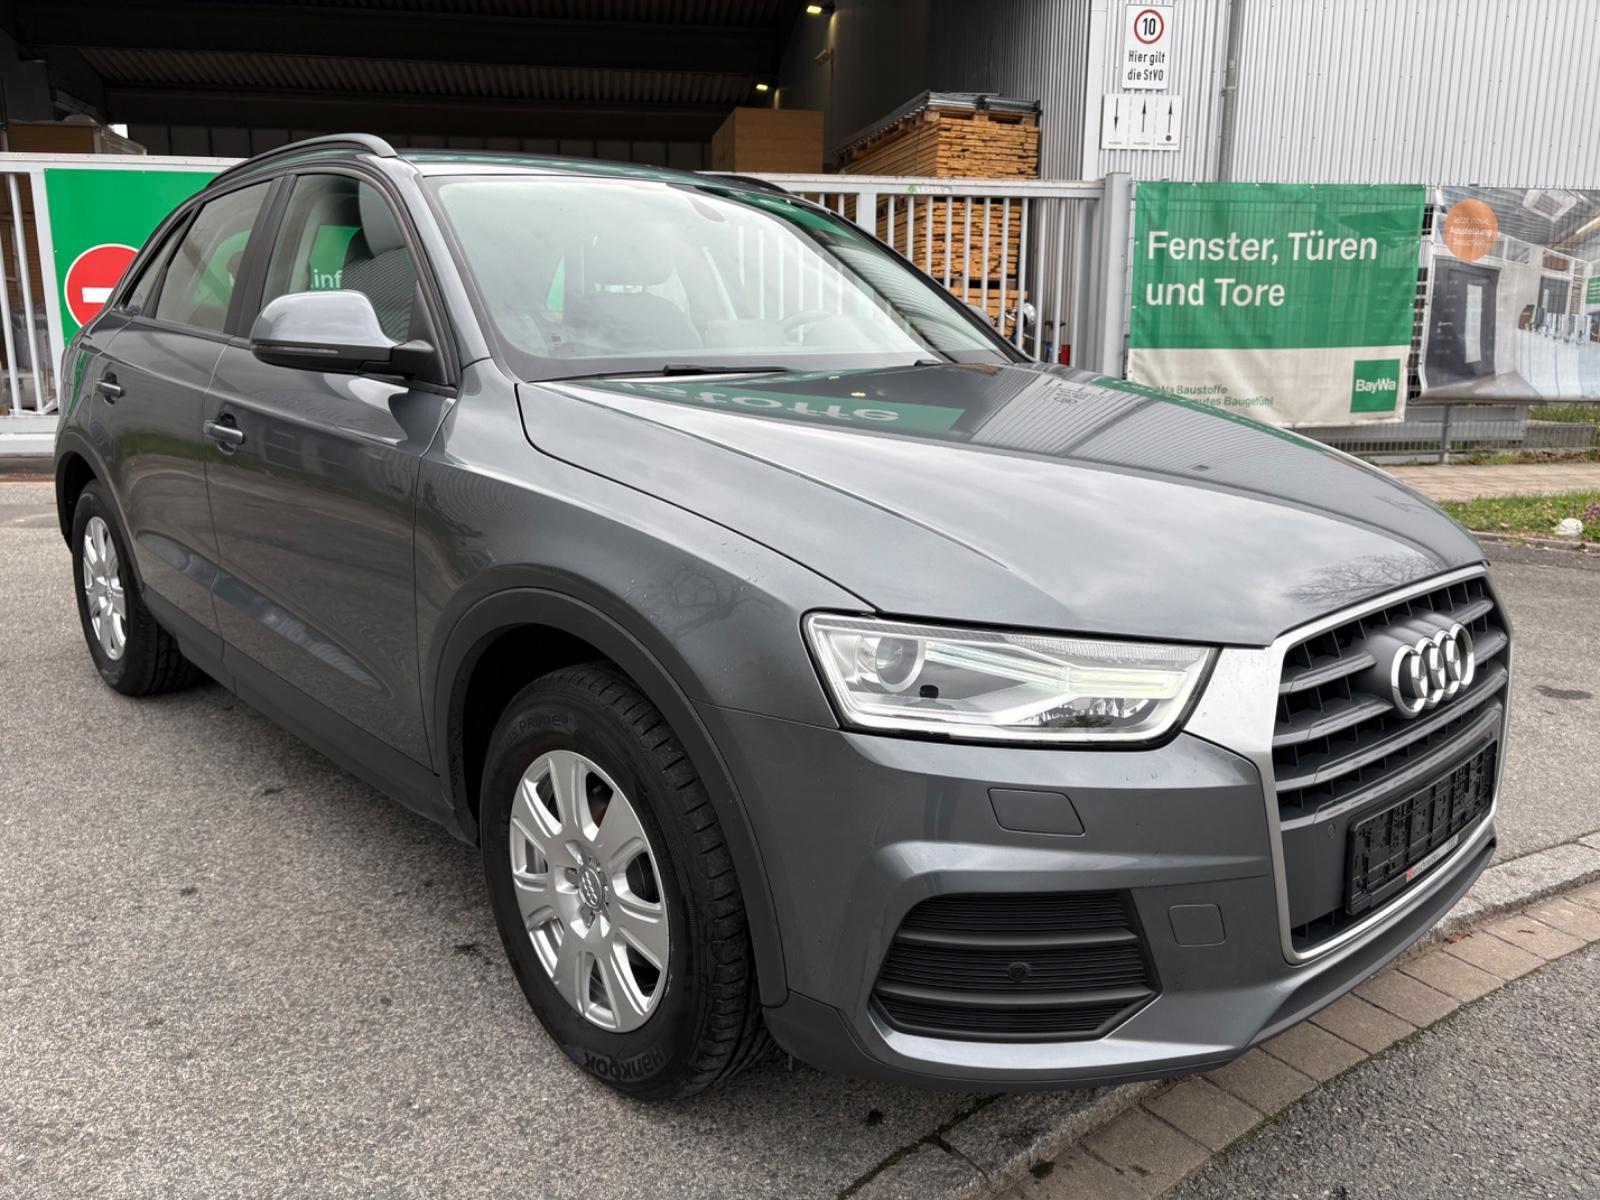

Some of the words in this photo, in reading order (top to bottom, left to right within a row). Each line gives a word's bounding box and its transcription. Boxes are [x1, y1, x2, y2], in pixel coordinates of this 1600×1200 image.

[1142, 17, 1156, 36] 10
[1128, 49, 1147, 63] Hier
[1149, 51, 1165, 66] gilt
[1127, 68, 1142, 81] die
[1143, 69, 1164, 82] StVO
[1148, 230, 1278, 265] Fenster,
[1288, 229, 1378, 261] Türen
[1145, 277, 1205, 306] und
[1214, 277, 1286, 307] Tore
[1176, 384, 1228, 395] Baustoffe
[1355, 377, 1396, 394] BayWa
[1223, 395, 1275, 408] Baugefühl
